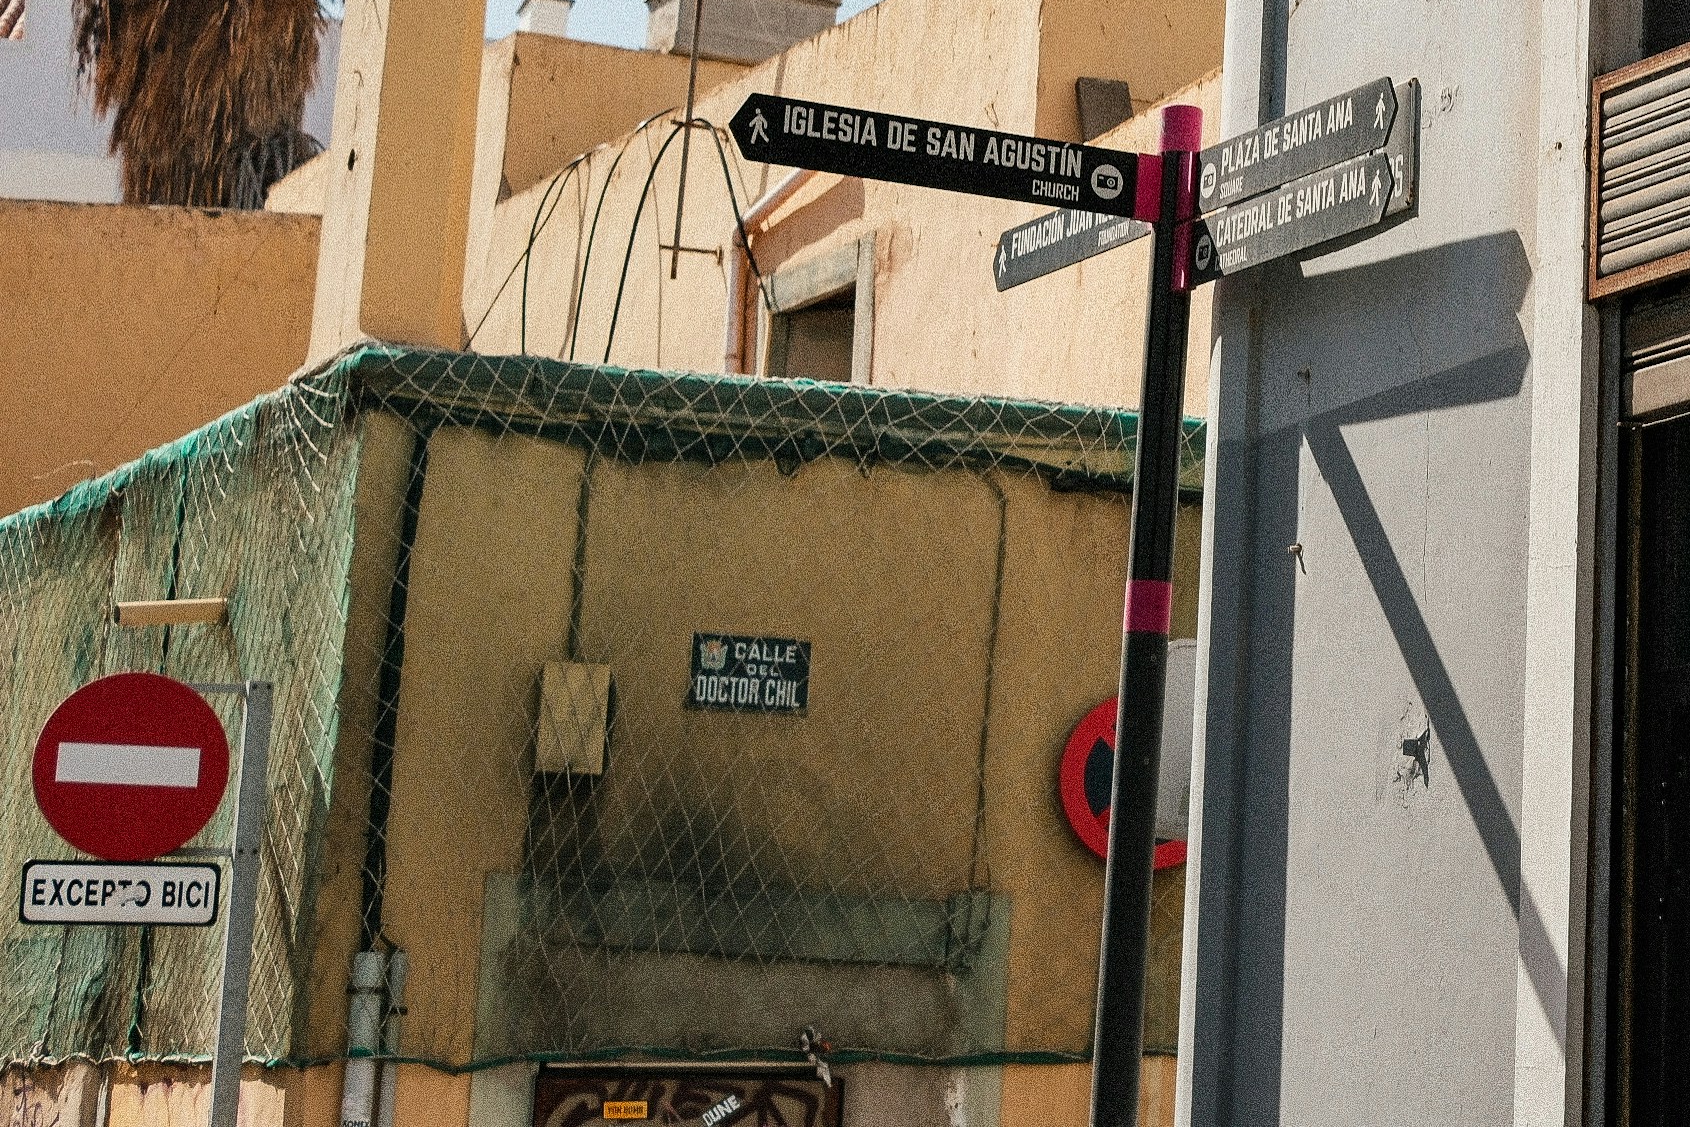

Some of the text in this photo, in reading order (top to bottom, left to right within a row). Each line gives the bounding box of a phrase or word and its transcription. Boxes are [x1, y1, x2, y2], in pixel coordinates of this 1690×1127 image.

[783, 104, 1083, 179] IGLESIA DE SAN AGUSTÍN
[1221, 98, 1354, 176] PLAZA DE SANTA ANA
[1031, 178, 1079, 202] CHURCH
[1219, 175, 1244, 200] SQUARE
[1216, 203, 1274, 248] CATEDRAL
[1277, 192, 1294, 226] DE
[1296, 178, 1335, 219] SANTA
[1339, 166, 1366, 204] ANA
[1011, 209, 1093, 260] FUNDACIÓN JUAN
[1214, 245, 1248, 272] CATHEDRAL
[735, 642, 797, 663] CALLE
[746, 663, 779, 677] DEL
[695, 675, 800, 707] DOCTOR CHIL
[161, 880, 210, 908] BICI
[702, 1094, 741, 1127] DUNE
